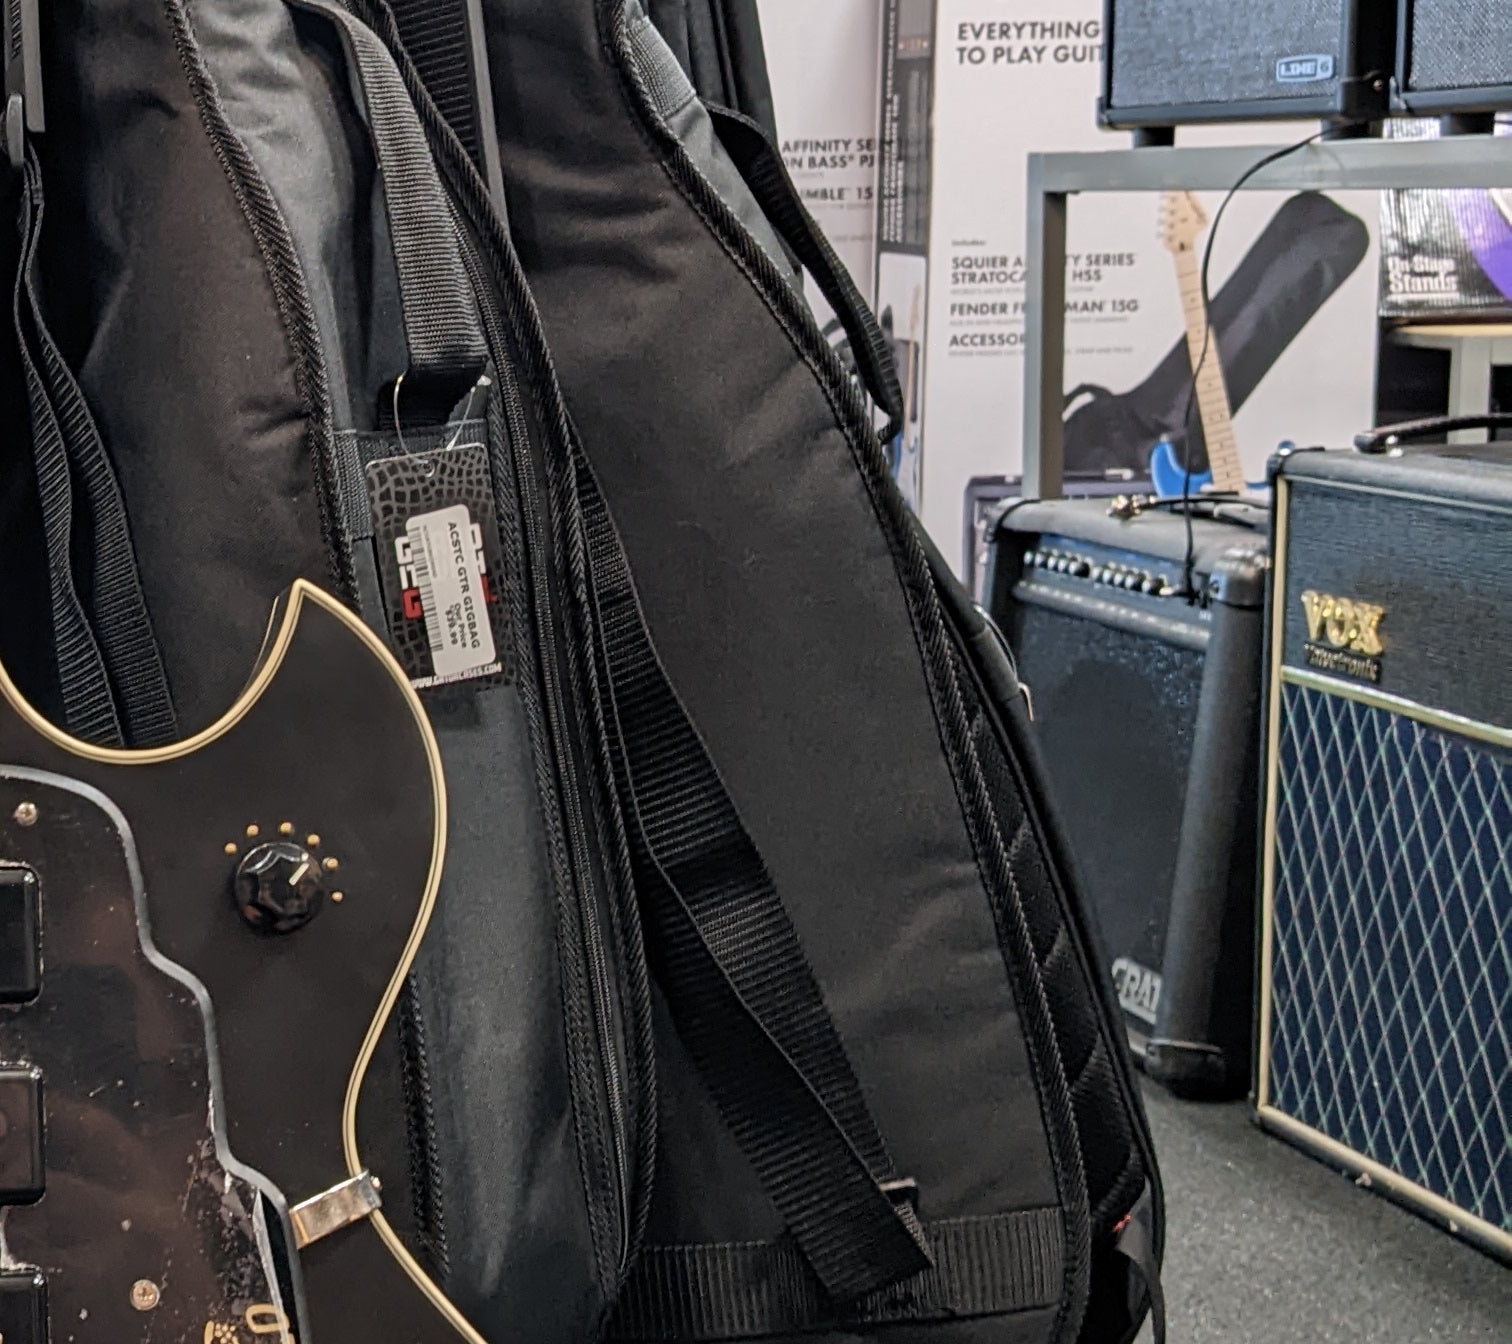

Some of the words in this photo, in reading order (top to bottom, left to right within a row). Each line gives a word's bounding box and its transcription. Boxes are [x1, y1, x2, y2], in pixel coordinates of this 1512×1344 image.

[957, 20, 1099, 41] EVERYTHING
[957, 46, 986, 65] TO
[993, 45, 1046, 65] PLAY
[1053, 42, 1102, 63] GUI
[1280, 61, 1316, 76] LINE
[782, 139, 851, 153] AFFINITY
[800, 188, 845, 200] MBLE
[952, 256, 1007, 269] SQUIER
[1085, 253, 1135, 266] SERIES
[951, 270, 1026, 284] STRATOC
[1072, 269, 1102, 282] HSS
[1389, 274, 1458, 293] Stands
[950, 302, 1008, 316] FENDER
[1112, 299, 1138, 313] 15G
[949, 333, 1026, 347] ACCESSO
[447, 522, 465, 564] ACSTC
[457, 565, 470, 595] GTR
[463, 596, 481, 649] GIGBAG
[1300, 590, 1384, 656] VOX
[457, 618, 468, 648] Price
[1112, 958, 1161, 1013] CRAT
